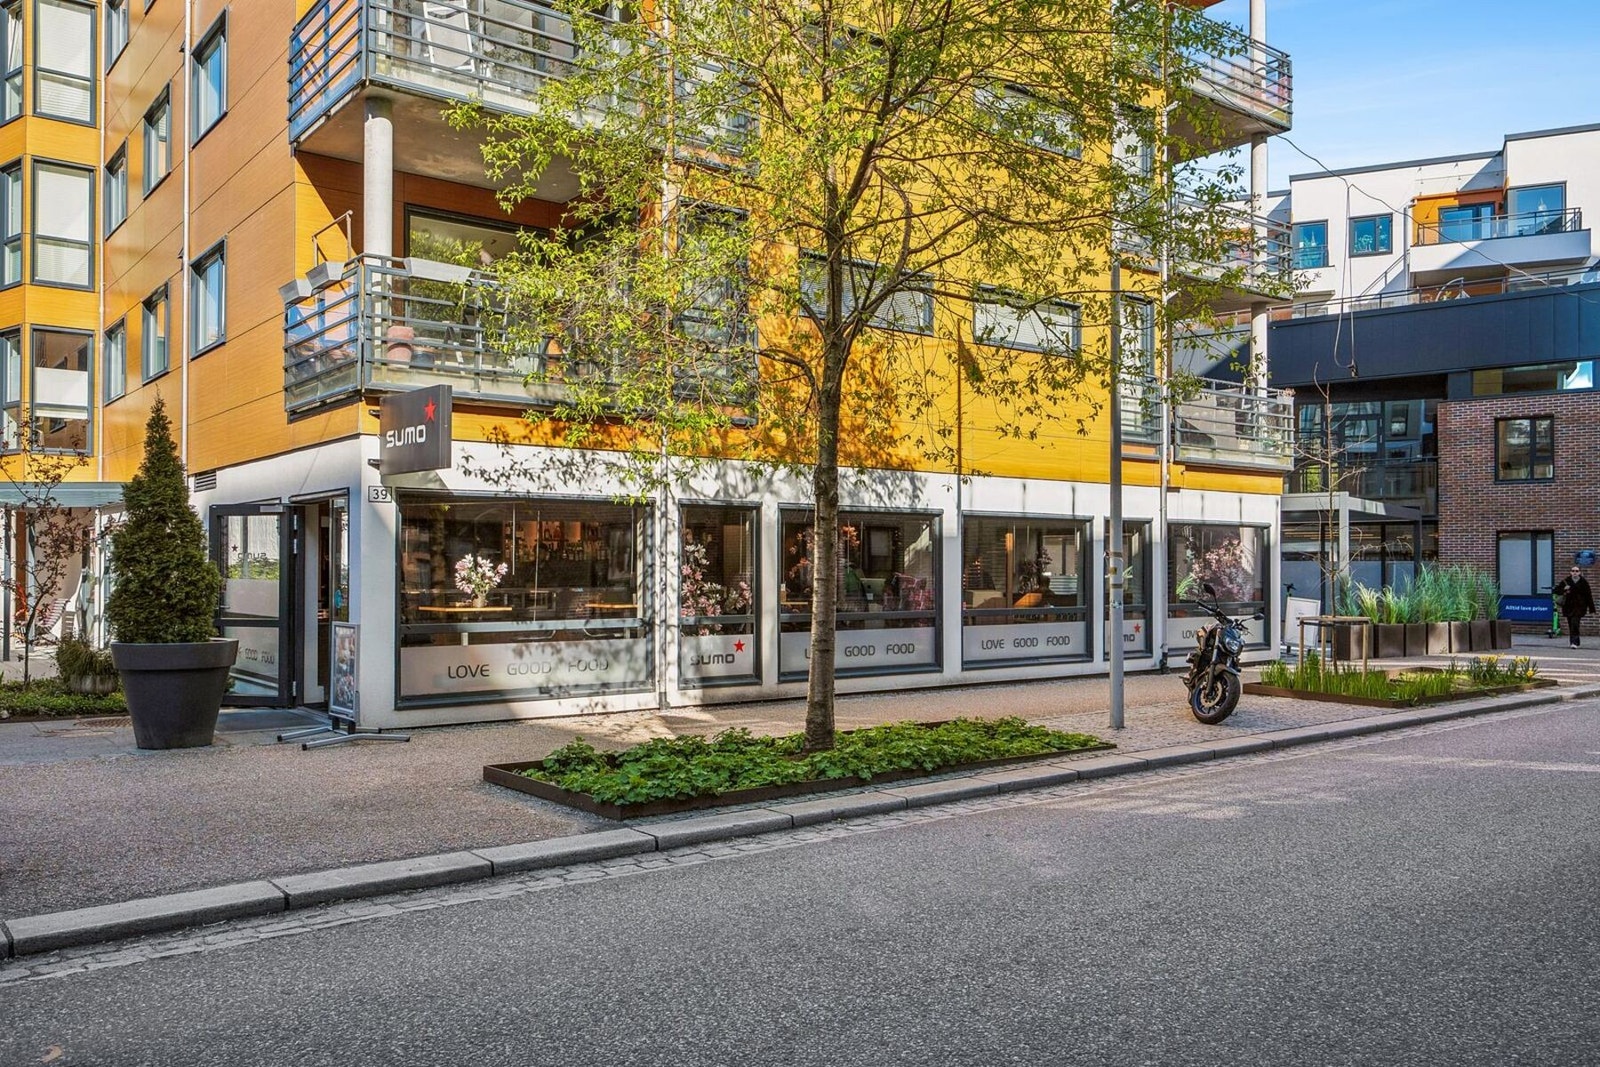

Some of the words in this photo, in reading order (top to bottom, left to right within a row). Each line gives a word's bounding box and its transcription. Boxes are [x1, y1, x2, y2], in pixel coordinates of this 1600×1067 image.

[386, 424, 426, 448] SUMO
[373, 488, 388, 500] 39
[1182, 630, 1195, 639] LOV
[844, 645, 876, 657] GOOD
[886, 643, 915, 655] FOOD
[981, 639, 1004, 650] LOVE
[1013, 638, 1038, 648] GOOD
[1047, 636, 1070, 646] FOOD
[690, 653, 735, 665] SUMO
[448, 664, 490, 679] LOVE
[507, 662, 551, 676] GOOD
[568, 659, 608, 673] FOOD
